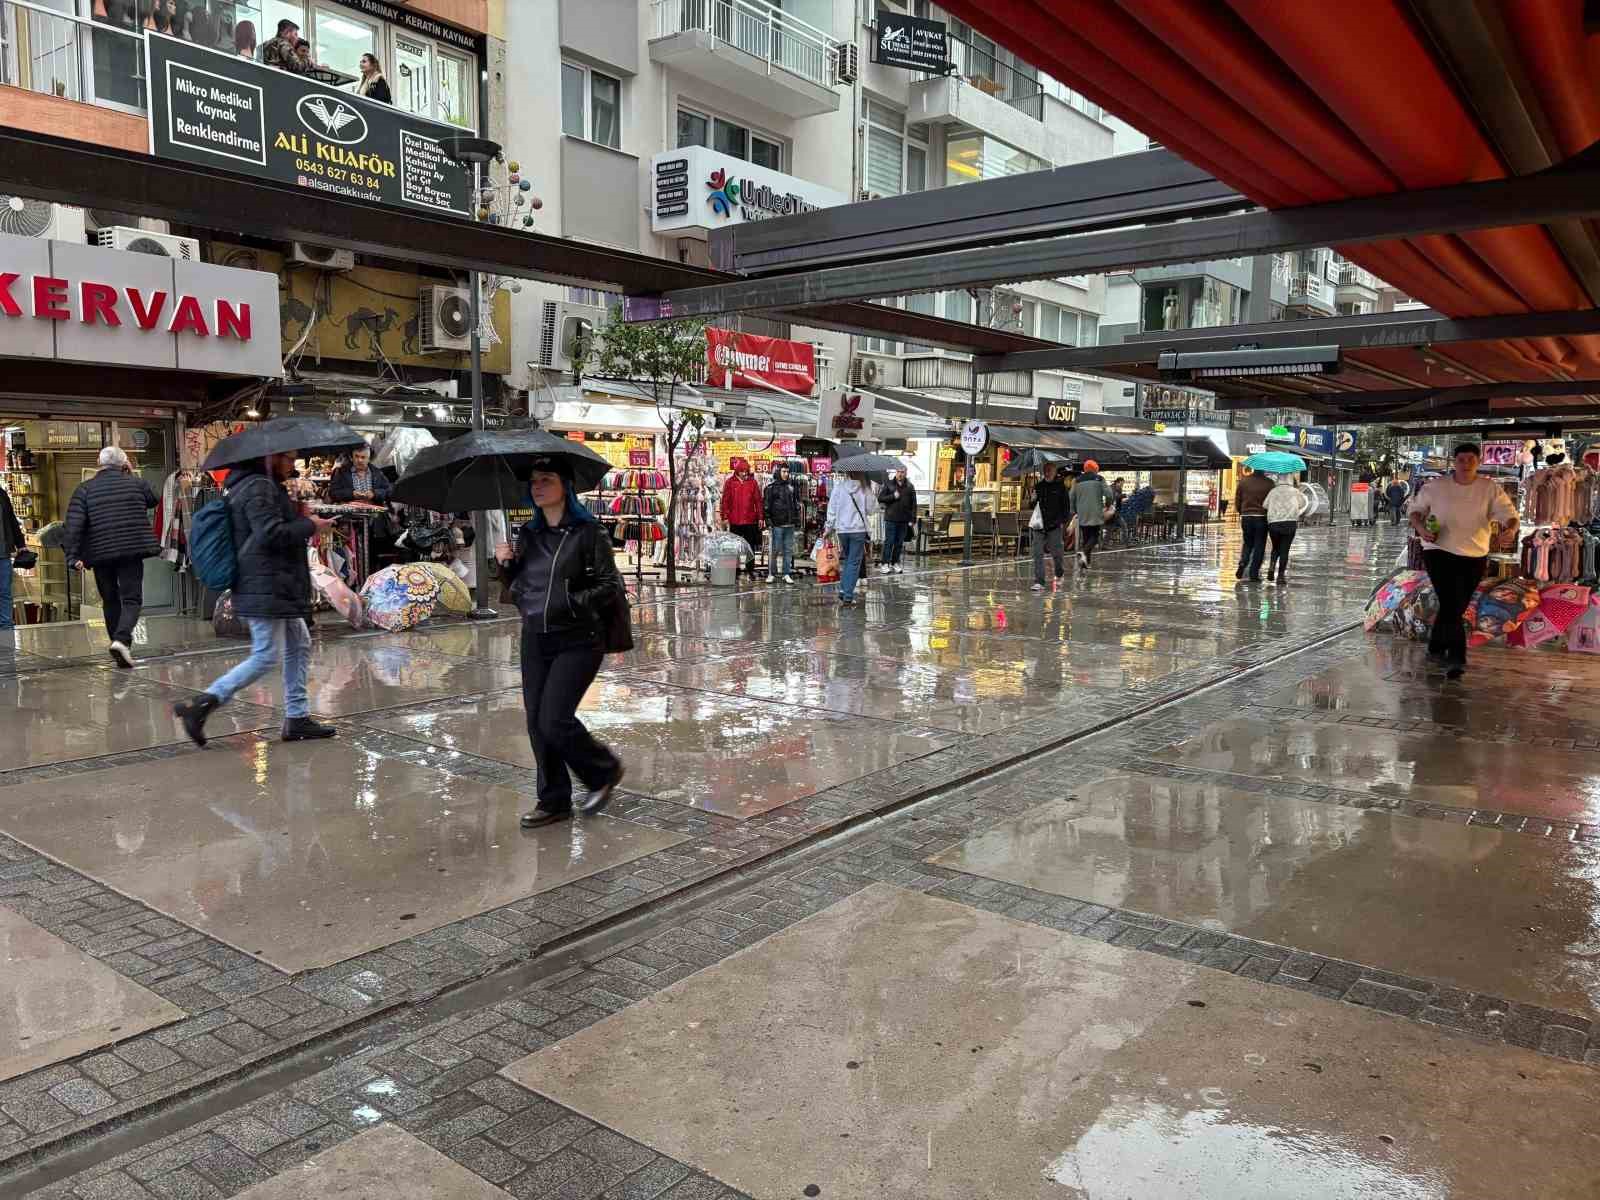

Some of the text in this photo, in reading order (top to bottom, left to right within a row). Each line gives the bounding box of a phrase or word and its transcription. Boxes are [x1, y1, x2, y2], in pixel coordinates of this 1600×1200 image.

[443, 25, 475, 48] KAYNAK
[915, 29, 942, 40] AVUKAT
[176, 77, 252, 110] Mikro Medikal
[196, 100, 237, 122] Kaynak
[176, 117, 260, 152] Renklendirme
[404, 135, 422, 149] Özel
[274, 131, 396, 178] ALİ KUAFÖR
[405, 147, 440, 163] Medikal
[296, 158, 380, 190] 0543 627 63 84
[433, 171, 444, 182] Ay
[406, 181, 422, 193] Bay
[0, 272, 252, 342] KERVAN
[1048, 401, 1077, 421] ÖZSÜT
